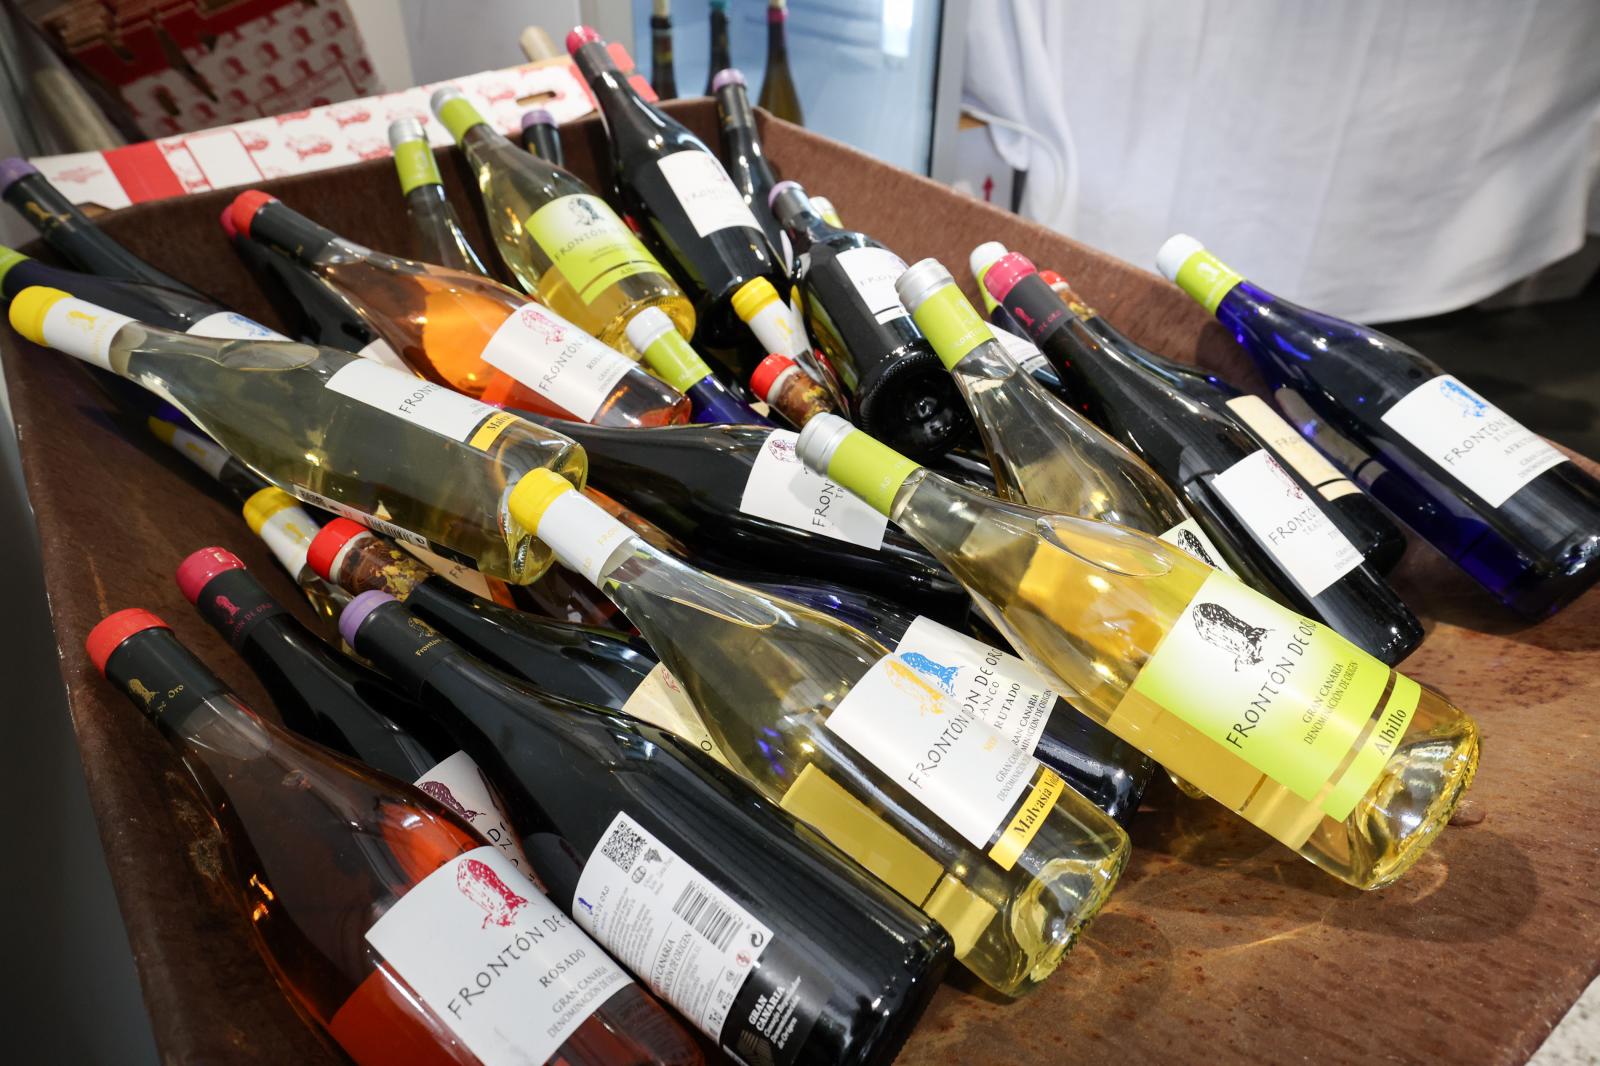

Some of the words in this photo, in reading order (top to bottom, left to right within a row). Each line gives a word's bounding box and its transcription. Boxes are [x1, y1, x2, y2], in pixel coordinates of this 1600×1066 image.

[168, 685, 184, 698] Oro
[975, 664, 993, 686] DE
[1226, 655, 1295, 749] FRONTÓN
[1287, 635, 1310, 657] DE
[1319, 663, 1343, 697] CANARIA
[1020, 694, 1039, 727] CANARIA
[1372, 709, 1407, 755] Albillo
[1013, 787, 1052, 838] Malvasía
[658, 939, 675, 973] CANARIA
[674, 933, 692, 966] ORIGEN
[447, 922, 544, 1020] FRONTÓN
[539, 948, 586, 988] ROSADO
[552, 987, 579, 1013] GRAN
[748, 994, 768, 1025] GRAN
[756, 986, 786, 1031] CANARIA
